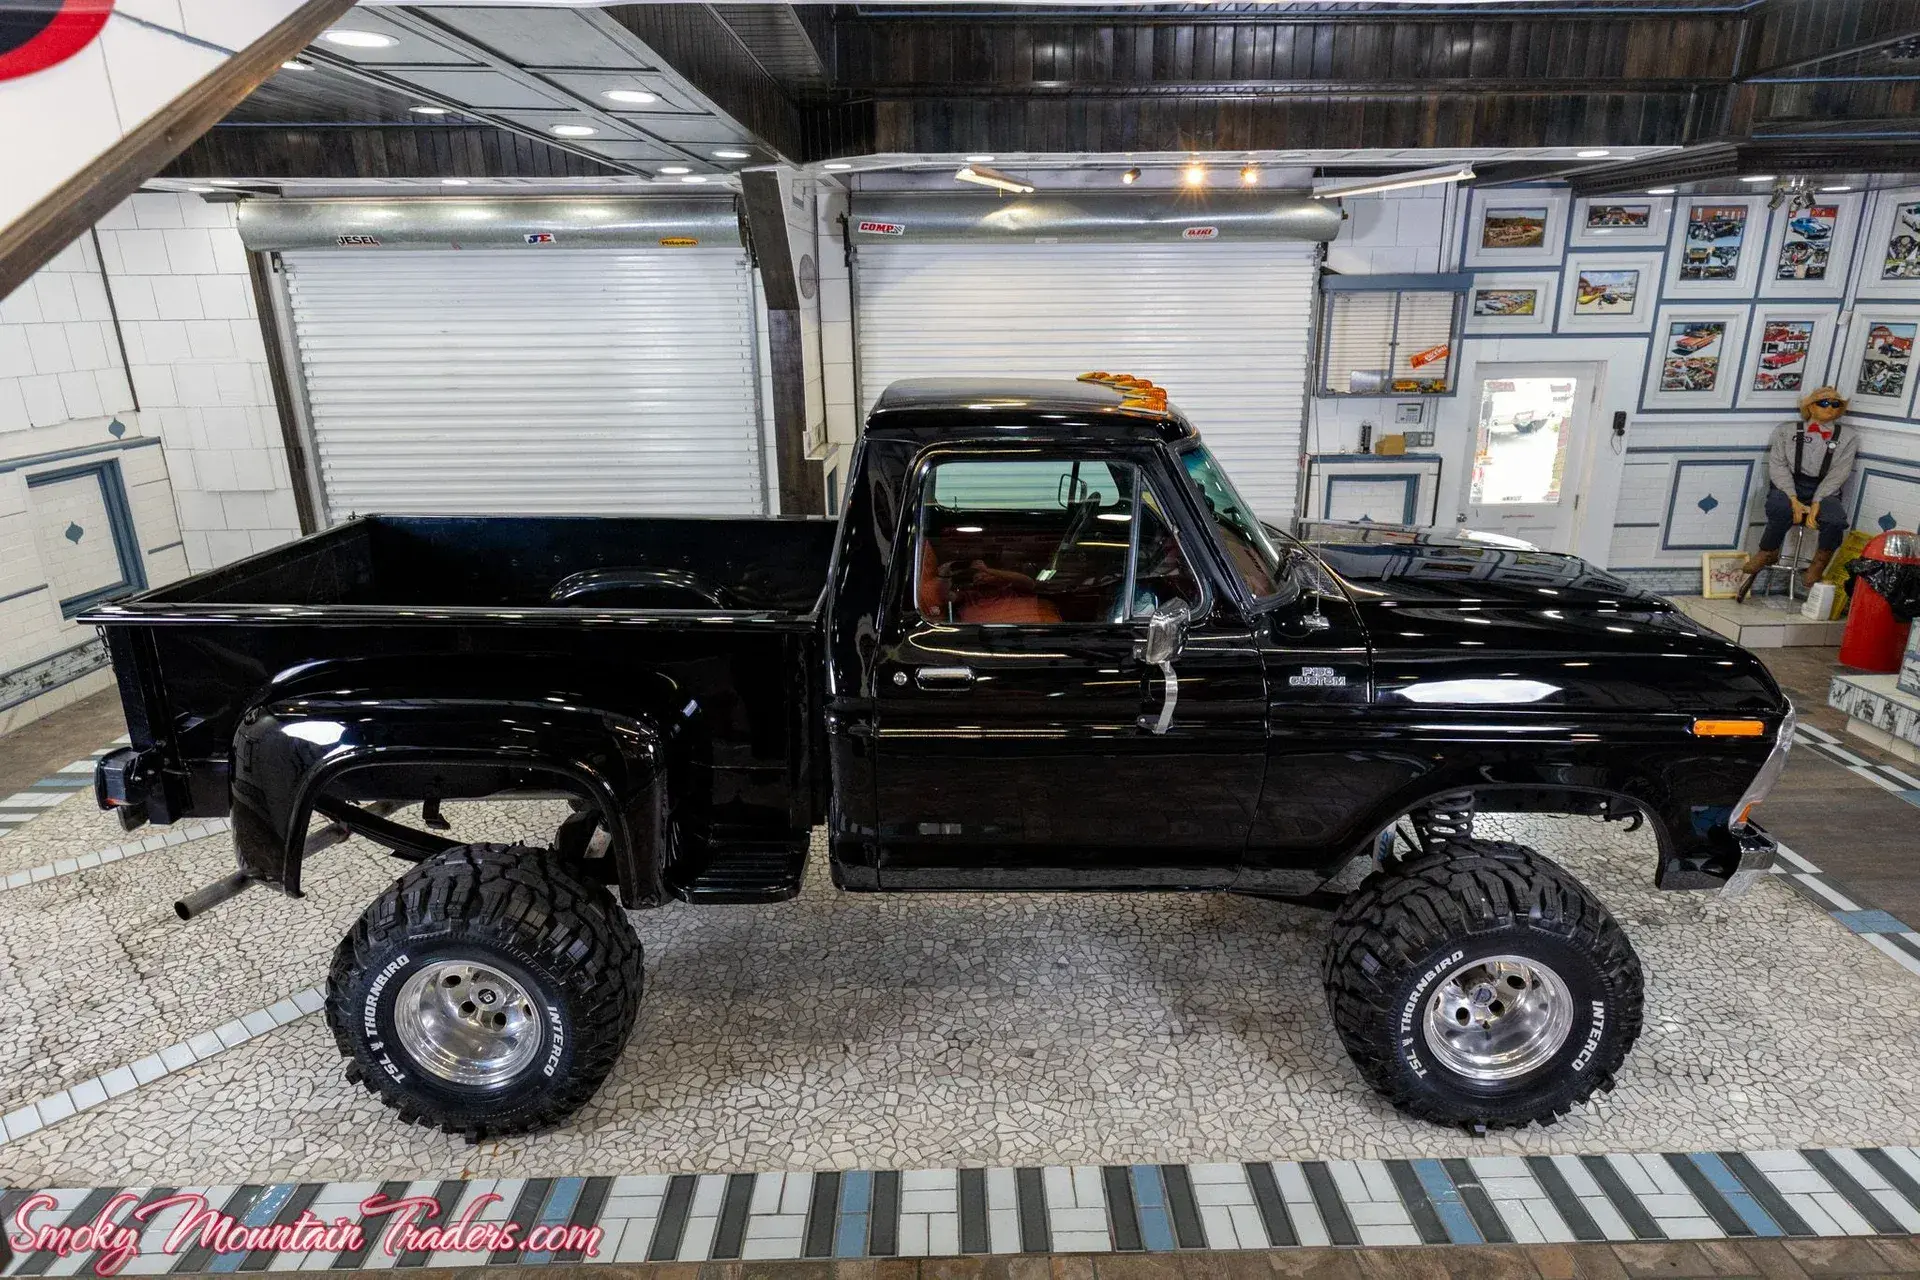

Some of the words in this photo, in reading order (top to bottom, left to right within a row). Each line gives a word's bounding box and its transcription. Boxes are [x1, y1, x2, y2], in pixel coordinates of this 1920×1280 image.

[337, 235, 380, 246] JESEL
[528, 234, 552, 244] JE
[860, 222, 895, 233] COMP
[1289, 676, 1346, 686] CUSTOM
[364, 954, 410, 1038] THORNBIRD
[1400, 950, 1464, 1034] THORNBIRD
[543, 1006, 564, 1077] INTERCO
[1571, 1000, 1605, 1071] INTERCO
[380, 1052, 406, 1084] TSL
[1406, 1048, 1428, 1079] TSL
